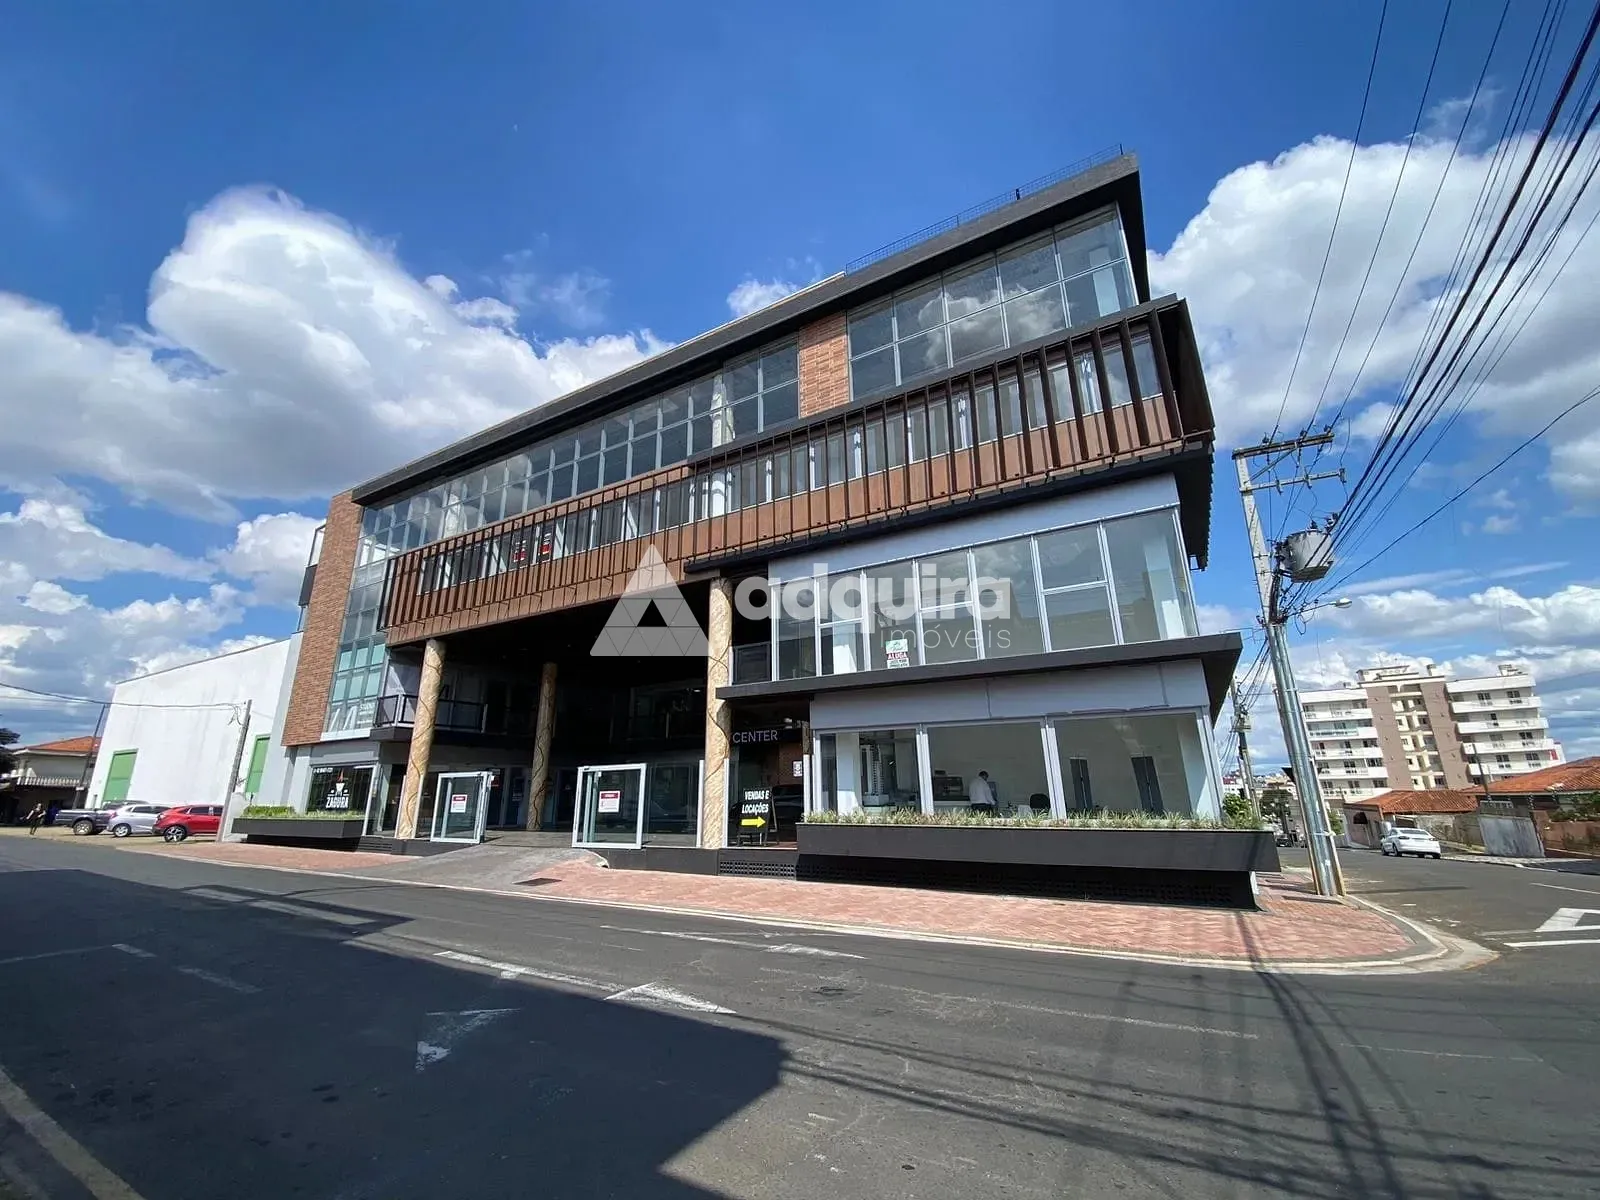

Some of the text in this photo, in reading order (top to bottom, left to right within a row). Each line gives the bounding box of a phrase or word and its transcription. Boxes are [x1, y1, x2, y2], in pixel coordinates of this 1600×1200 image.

[732, 730, 778, 743] CENTER
[744, 790, 770, 800] VENDAS E
[741, 802, 769, 815] LOCAÇÕES
